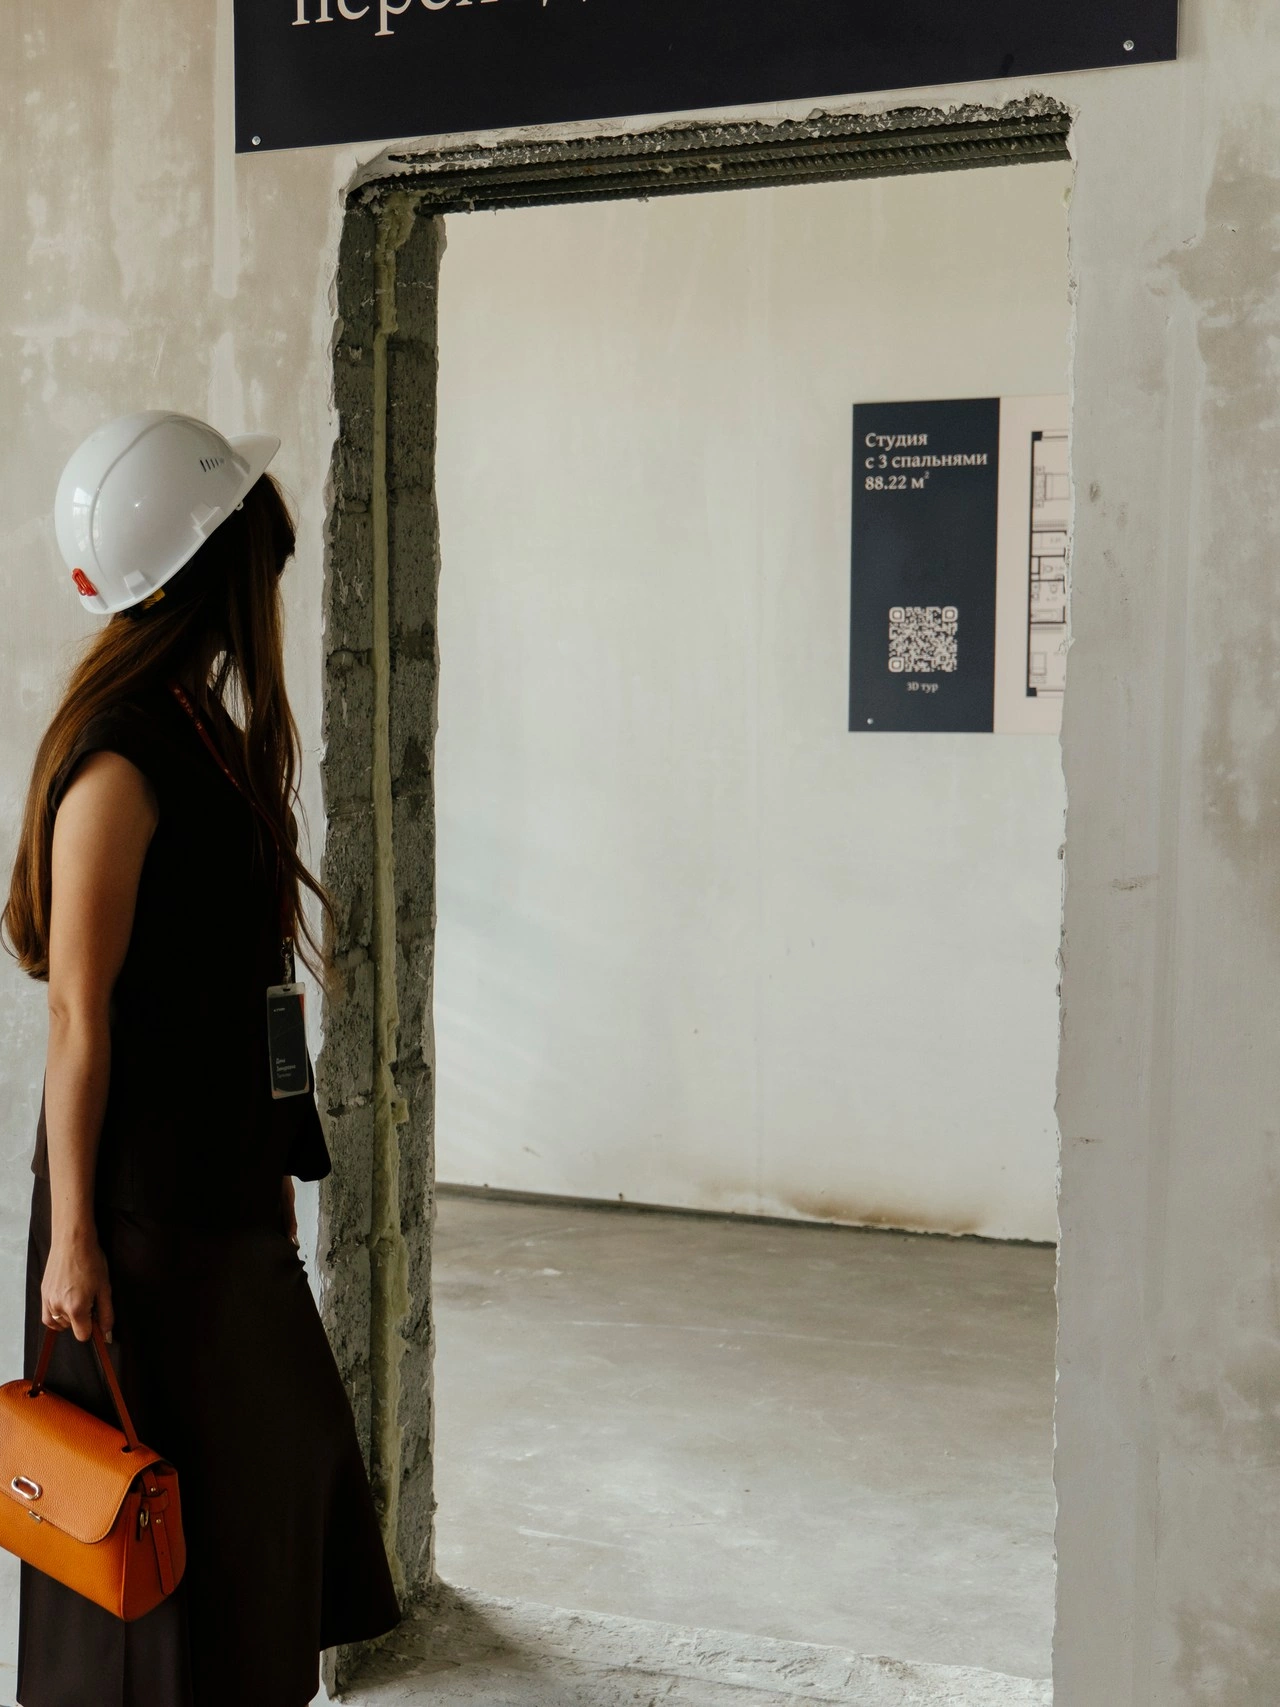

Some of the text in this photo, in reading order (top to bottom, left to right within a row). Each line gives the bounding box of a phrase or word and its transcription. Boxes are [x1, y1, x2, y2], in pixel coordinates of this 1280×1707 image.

[865, 432, 928, 451] Студия
[865, 453, 988, 469] с 3 спальнями
[865, 475, 907, 491] 88.22
[906, 682, 939, 693] 3D тур
